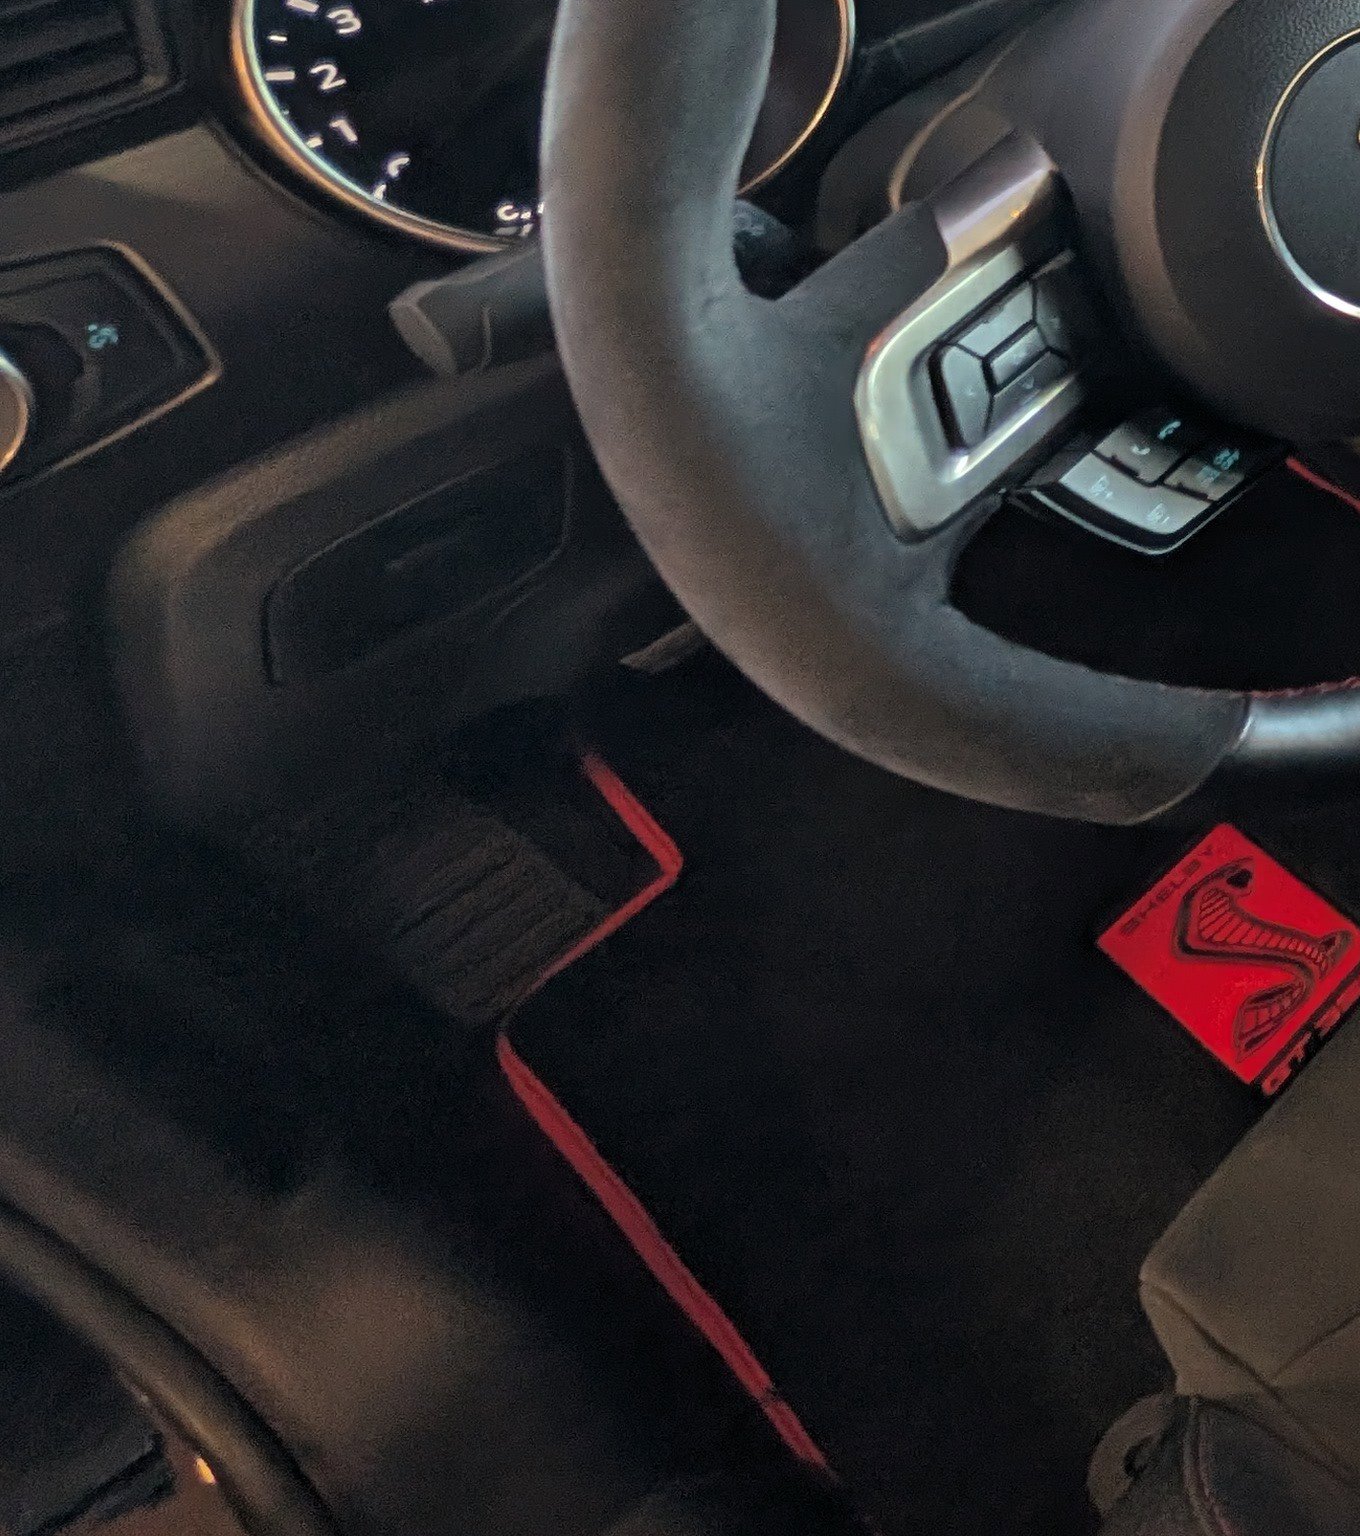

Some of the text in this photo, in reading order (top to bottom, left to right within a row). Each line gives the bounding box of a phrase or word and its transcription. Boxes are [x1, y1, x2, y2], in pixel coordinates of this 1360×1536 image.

[326, 8, 362, 35] 3
[309, 62, 347, 90] 2
[330, 118, 358, 142] 1
